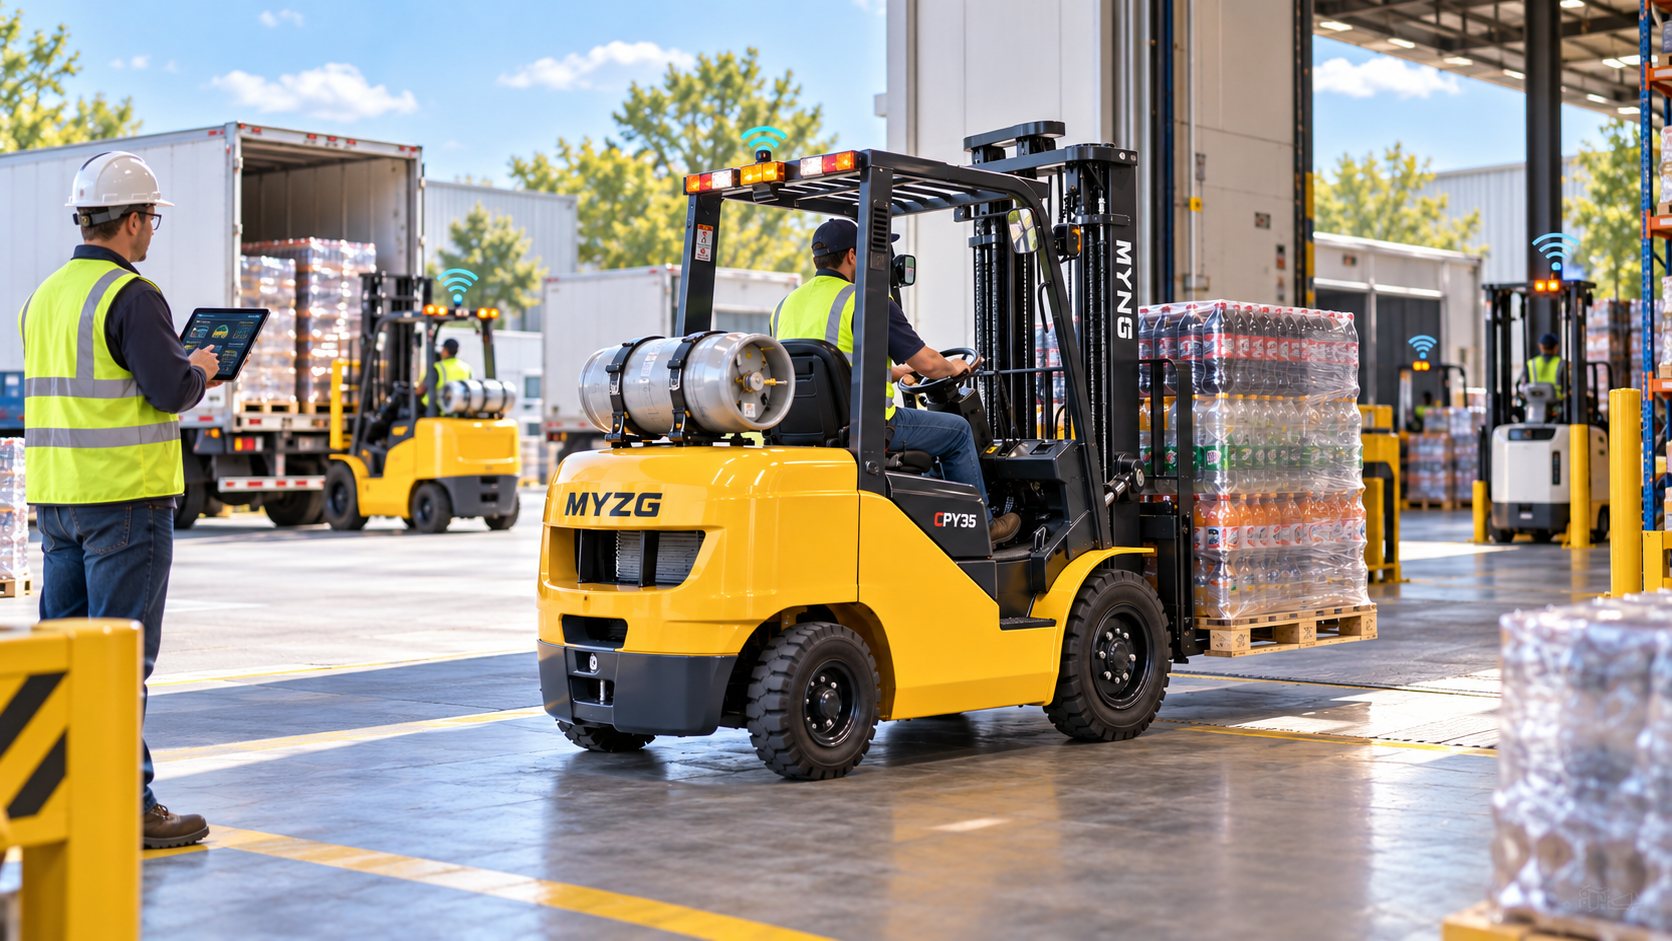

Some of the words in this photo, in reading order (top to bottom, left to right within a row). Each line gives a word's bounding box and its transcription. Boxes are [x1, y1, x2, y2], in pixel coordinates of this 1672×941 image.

[1116, 239, 1133, 340] MYNG
[564, 492, 663, 518] MYZG
[933, 511, 977, 528] CPY35
